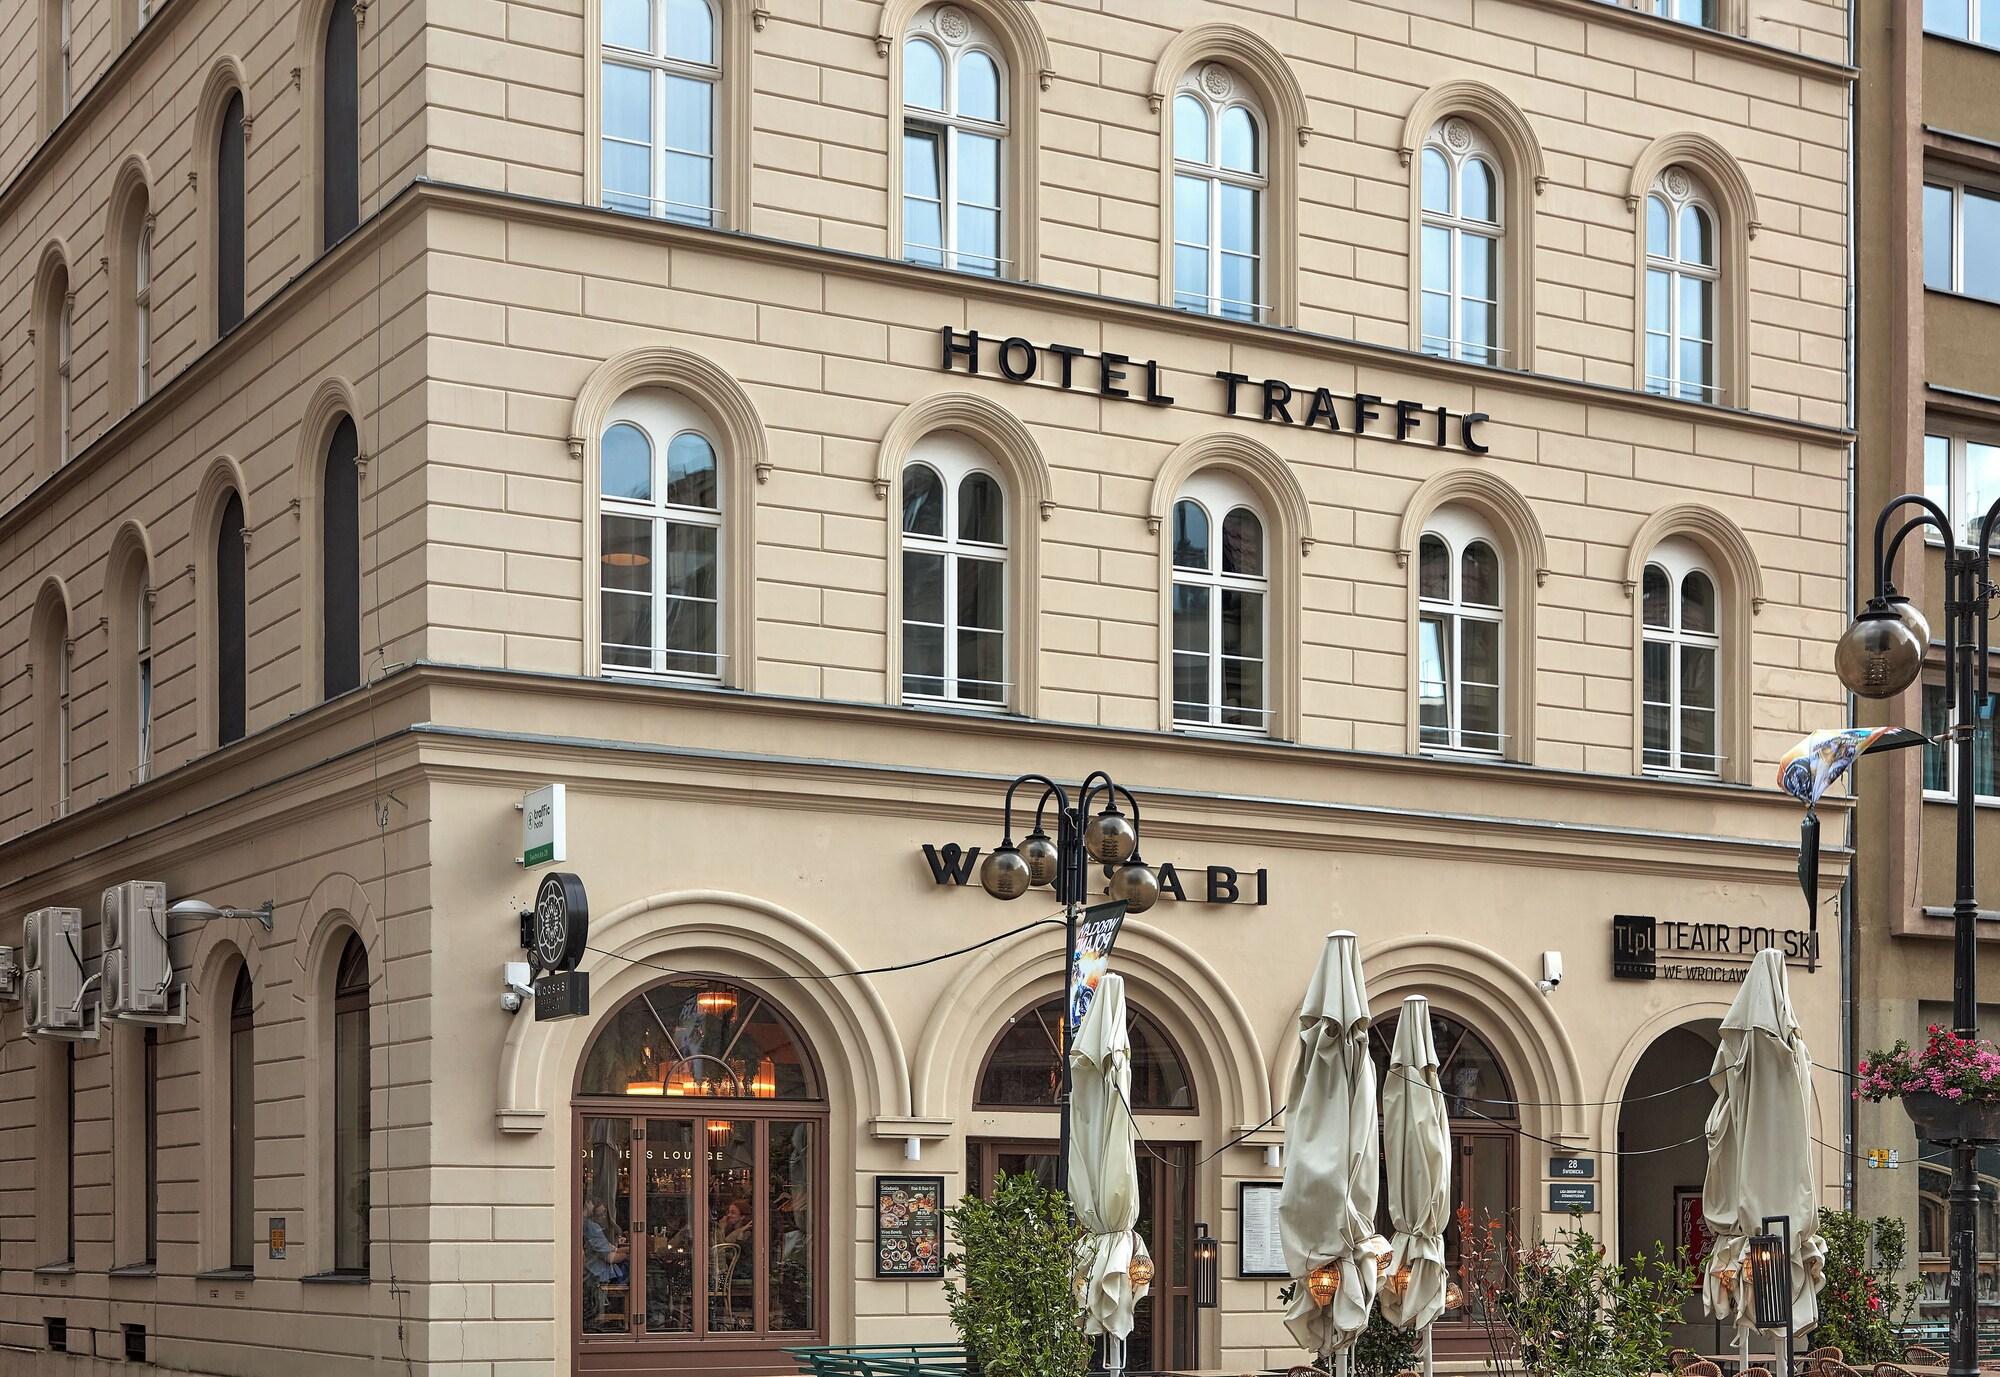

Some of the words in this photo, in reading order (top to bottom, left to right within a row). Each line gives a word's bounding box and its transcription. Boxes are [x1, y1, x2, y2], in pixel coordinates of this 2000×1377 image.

[942, 326, 1174, 405] HOTEL
[1216, 371, 1489, 453] TRAFFIC
[533, 804, 550, 820] traffic
[533, 818, 544, 829] hotel
[922, 843, 1267, 905] WABI
[1663, 921, 1730, 953] TEATR
[1664, 964, 1682, 979] WE
[1686, 965, 1750, 982] WROCŁAW
[663, 1151, 723, 1160] LOUGE
[1568, 1160, 1578, 1168] 28
